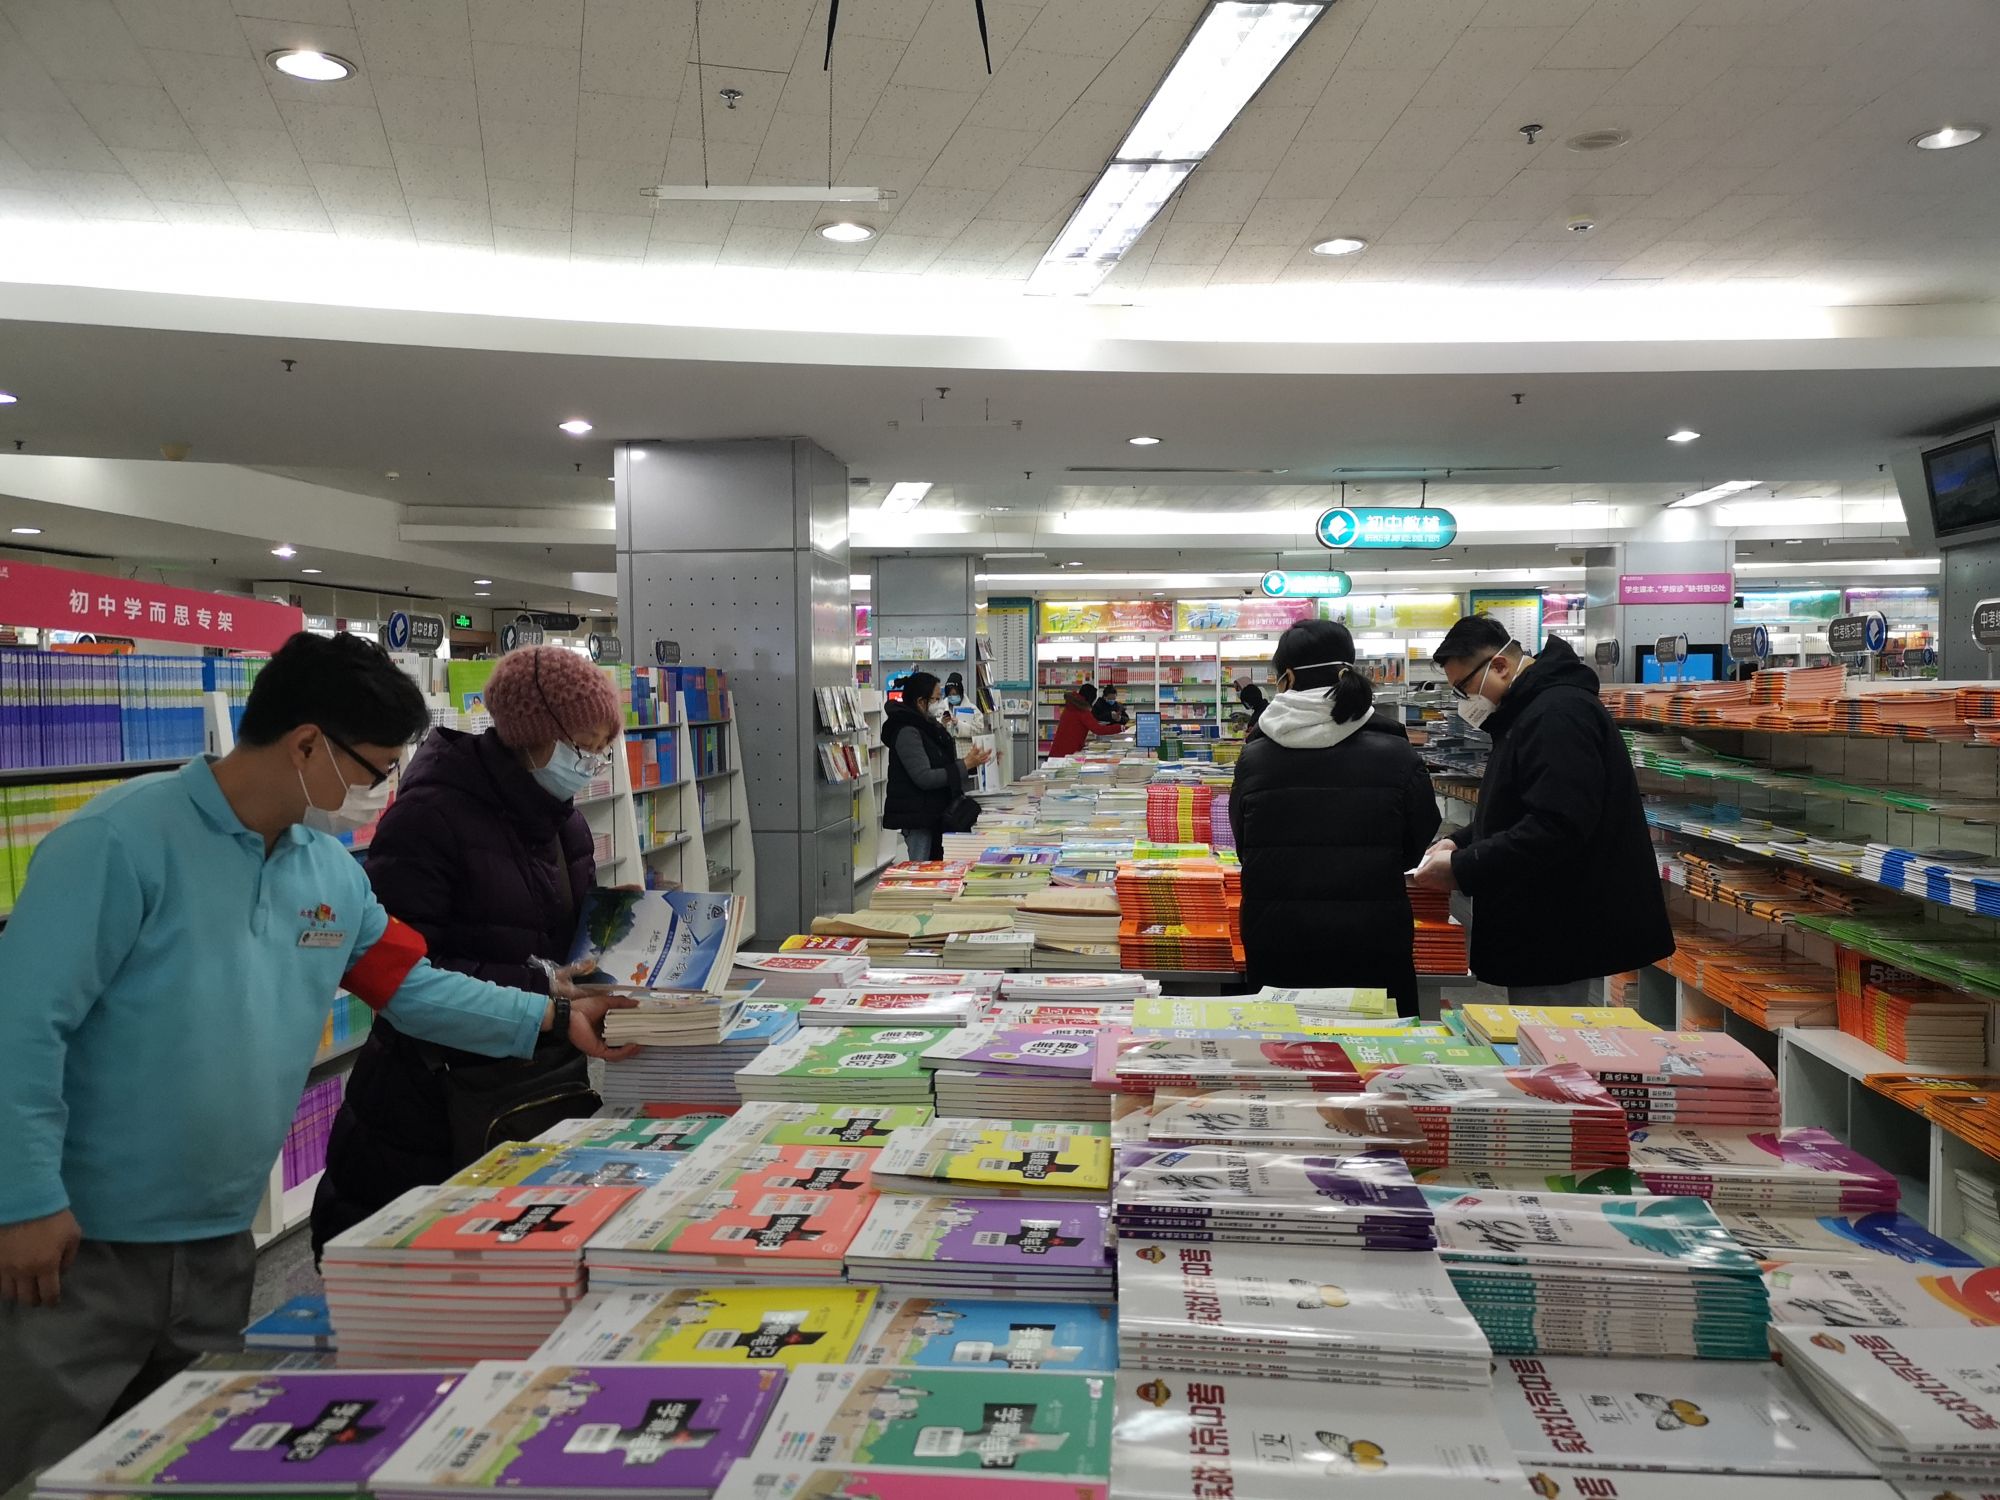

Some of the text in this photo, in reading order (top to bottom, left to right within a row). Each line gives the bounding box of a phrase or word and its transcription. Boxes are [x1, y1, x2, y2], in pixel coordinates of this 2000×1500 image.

[1366, 514, 1440, 532] 初中教辅
[68, 588, 233, 632] 初中学而思专架
[412, 622, 439, 638] 初中总复习
[1180, 1248, 1224, 1327] 实战北京中考
[1509, 1358, 1594, 1454] 实战北京中考
[1850, 1333, 2000, 1431] 实战北京中考
